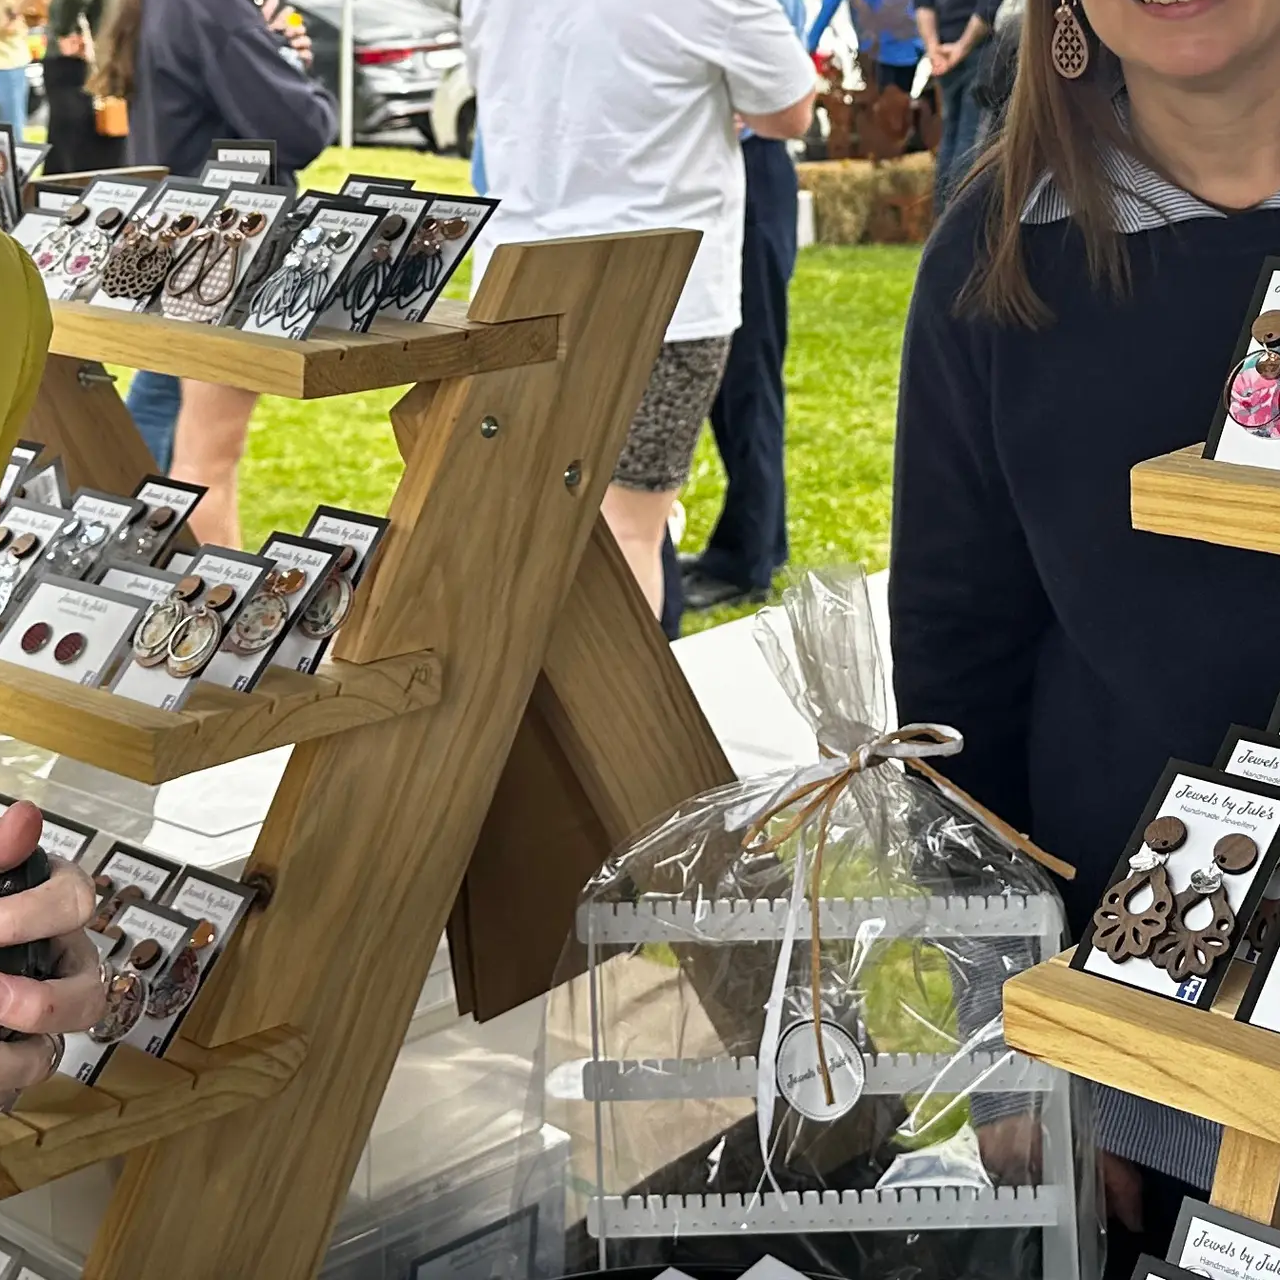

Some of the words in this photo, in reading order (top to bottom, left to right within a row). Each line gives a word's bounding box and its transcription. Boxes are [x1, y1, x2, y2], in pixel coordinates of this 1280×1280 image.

[1238, 749, 1279, 769] Jewels
[1176, 785, 1218, 805] Jewels
[1222, 797, 1236, 816] by
[1238, 801, 1274, 820] Jule's
[1193, 1230, 1235, 1257] Jewels
[1239, 1247, 1254, 1270] by
